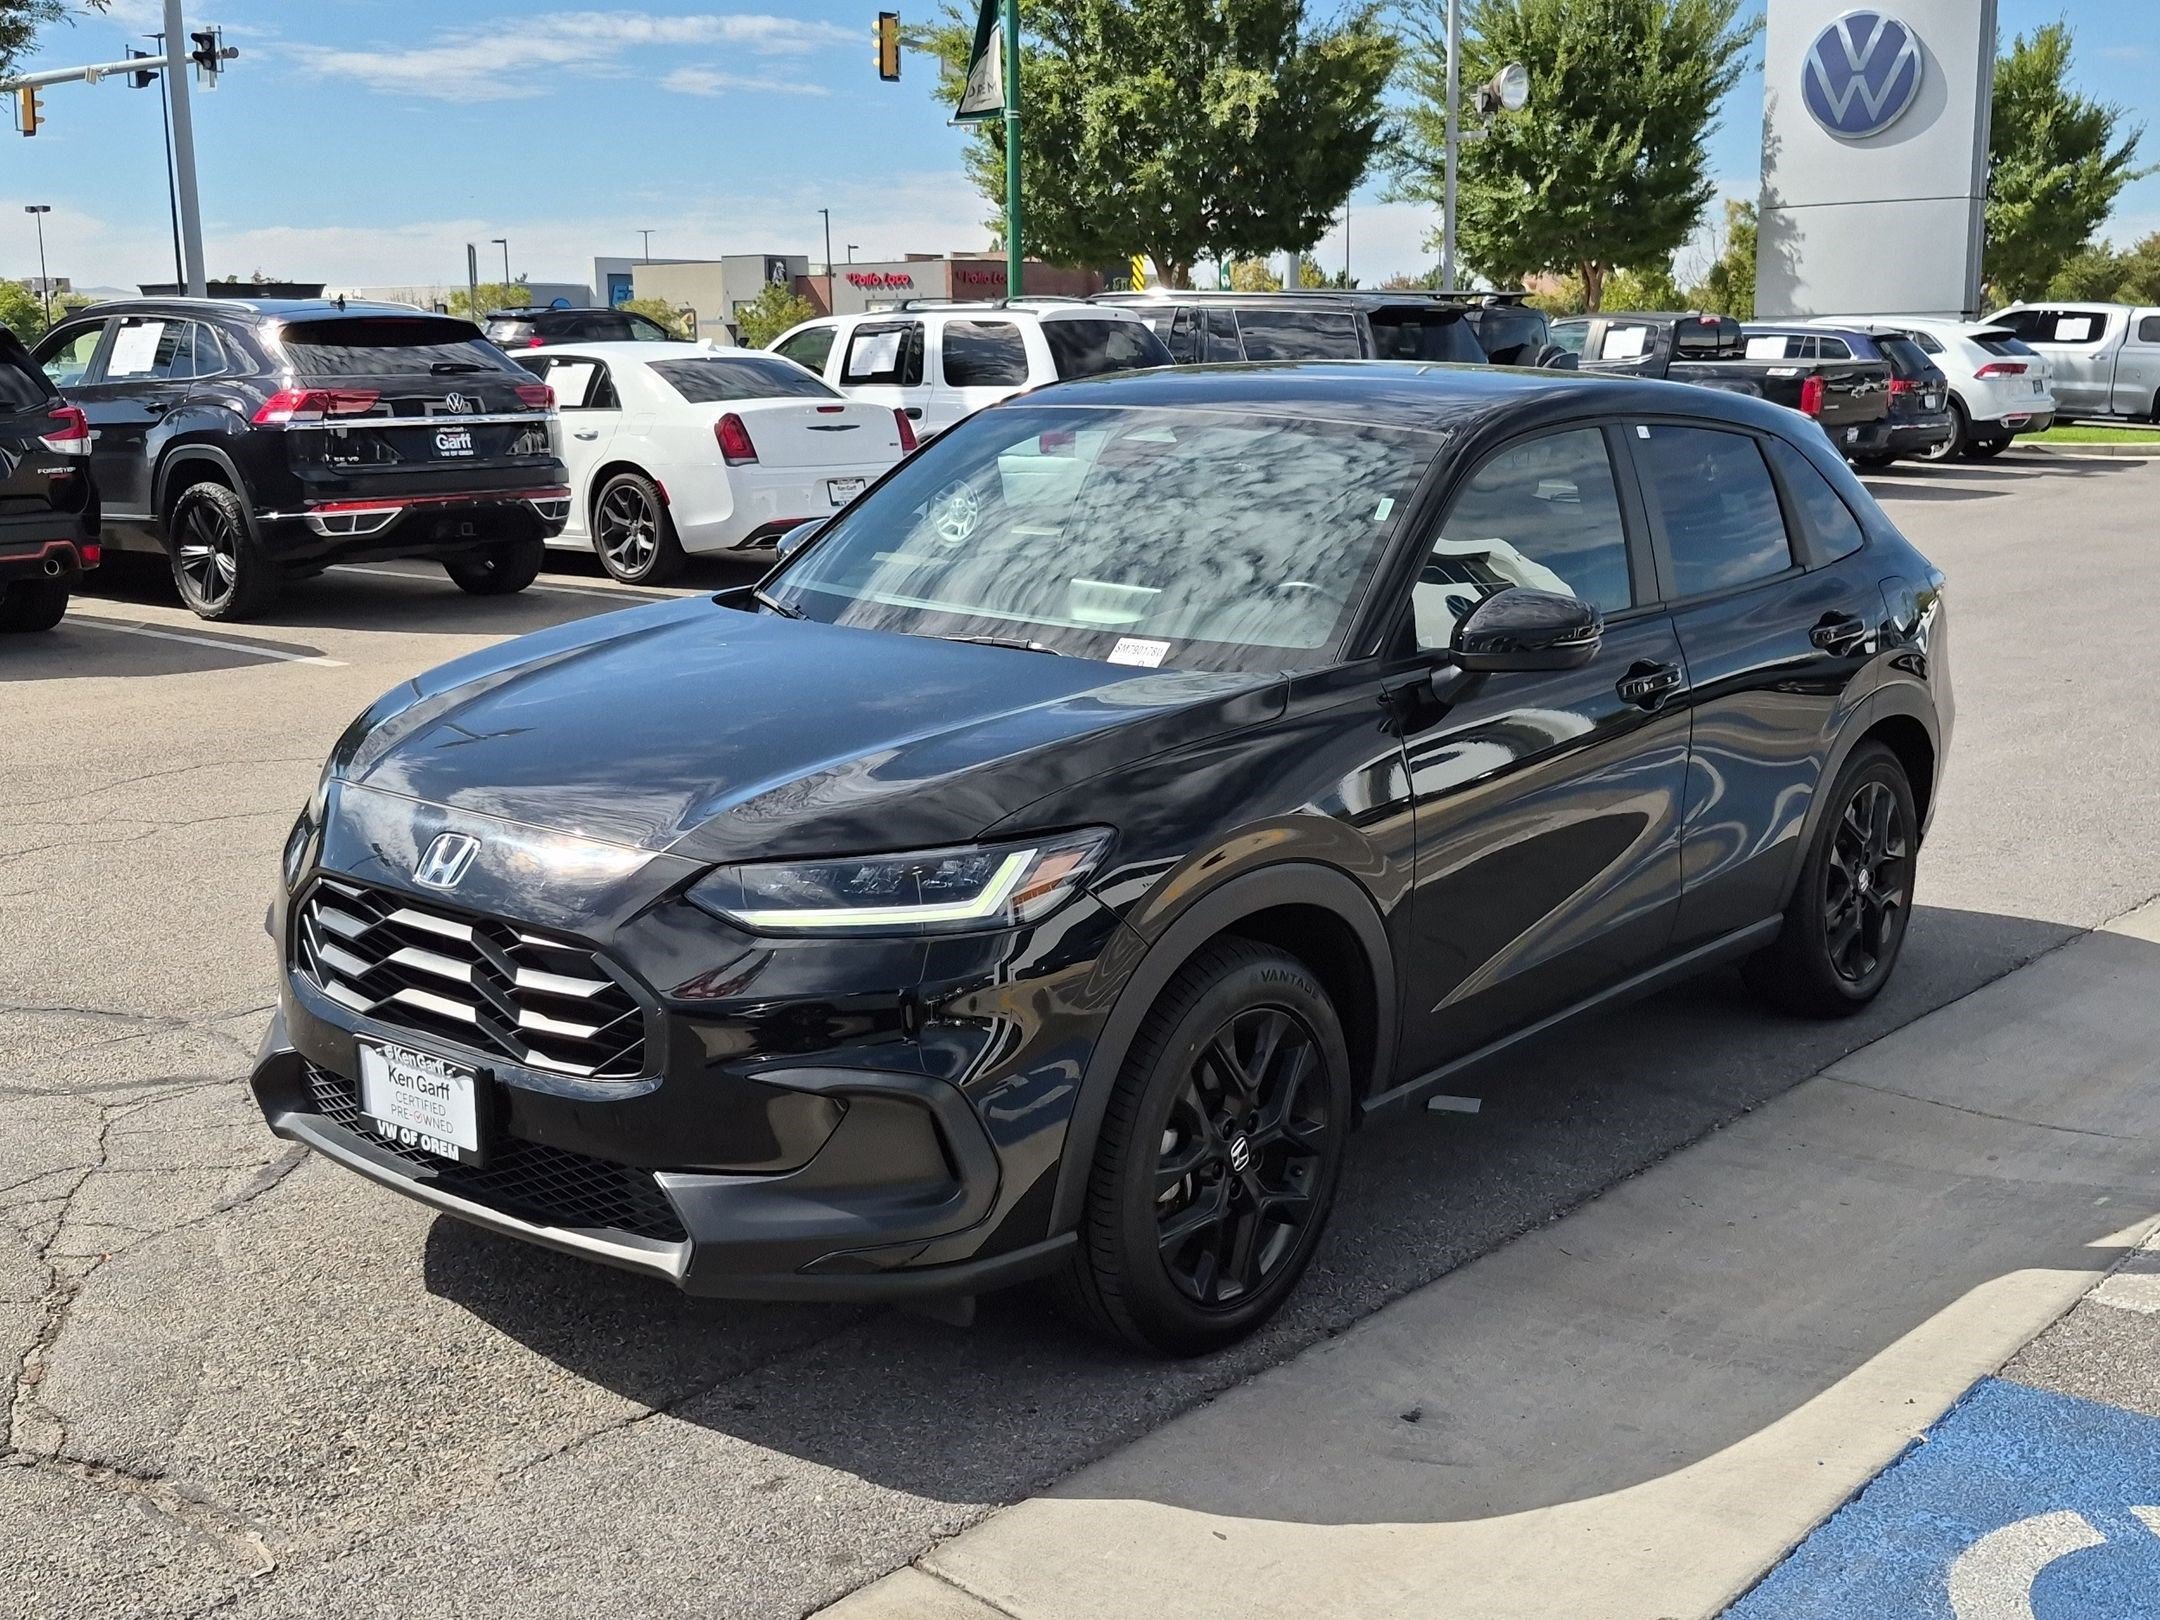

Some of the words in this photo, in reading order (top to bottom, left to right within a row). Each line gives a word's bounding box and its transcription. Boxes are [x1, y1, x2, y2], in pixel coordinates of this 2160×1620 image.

[436, 433, 471, 450] Garff
[393, 1046, 415, 1066] Ken
[416, 1054, 445, 1075] Garff
[388, 1064, 414, 1089] Ken
[416, 1076, 450, 1100] Garff
[395, 1091, 446, 1117] CERTIFIED
[377, 1119, 398, 1139] VW
[400, 1127, 418, 1146] OF
[420, 1134, 459, 1161] OREM
